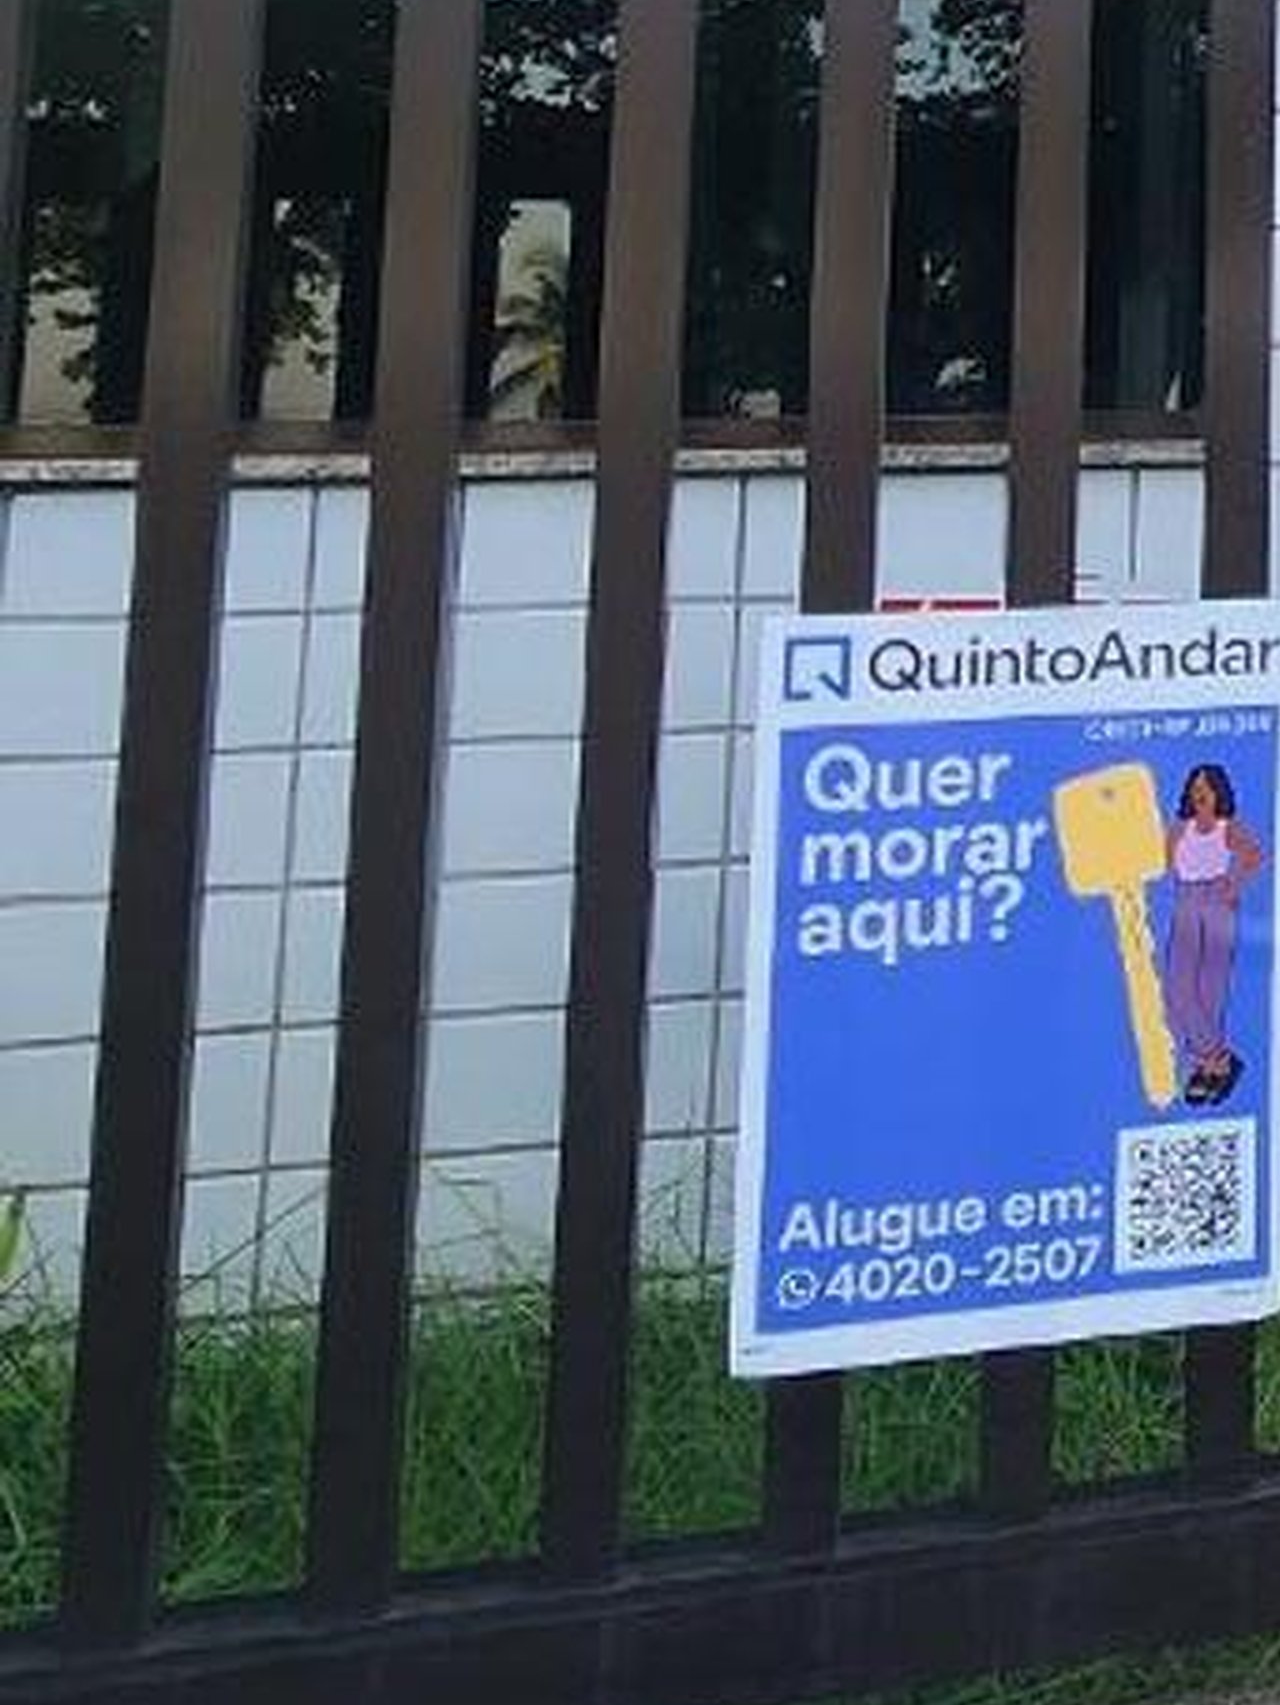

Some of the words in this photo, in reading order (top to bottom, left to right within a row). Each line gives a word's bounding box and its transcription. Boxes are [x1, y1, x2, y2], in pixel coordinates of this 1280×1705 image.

[804, 743, 1011, 814] Quer
[800, 816, 1049, 886] morar
[797, 882, 1023, 965] aqui?
[780, 1191, 986, 1256] Alugue
[1001, 1179, 1105, 1229] em:
[824, 1239, 1102, 1305] 4020-2507
